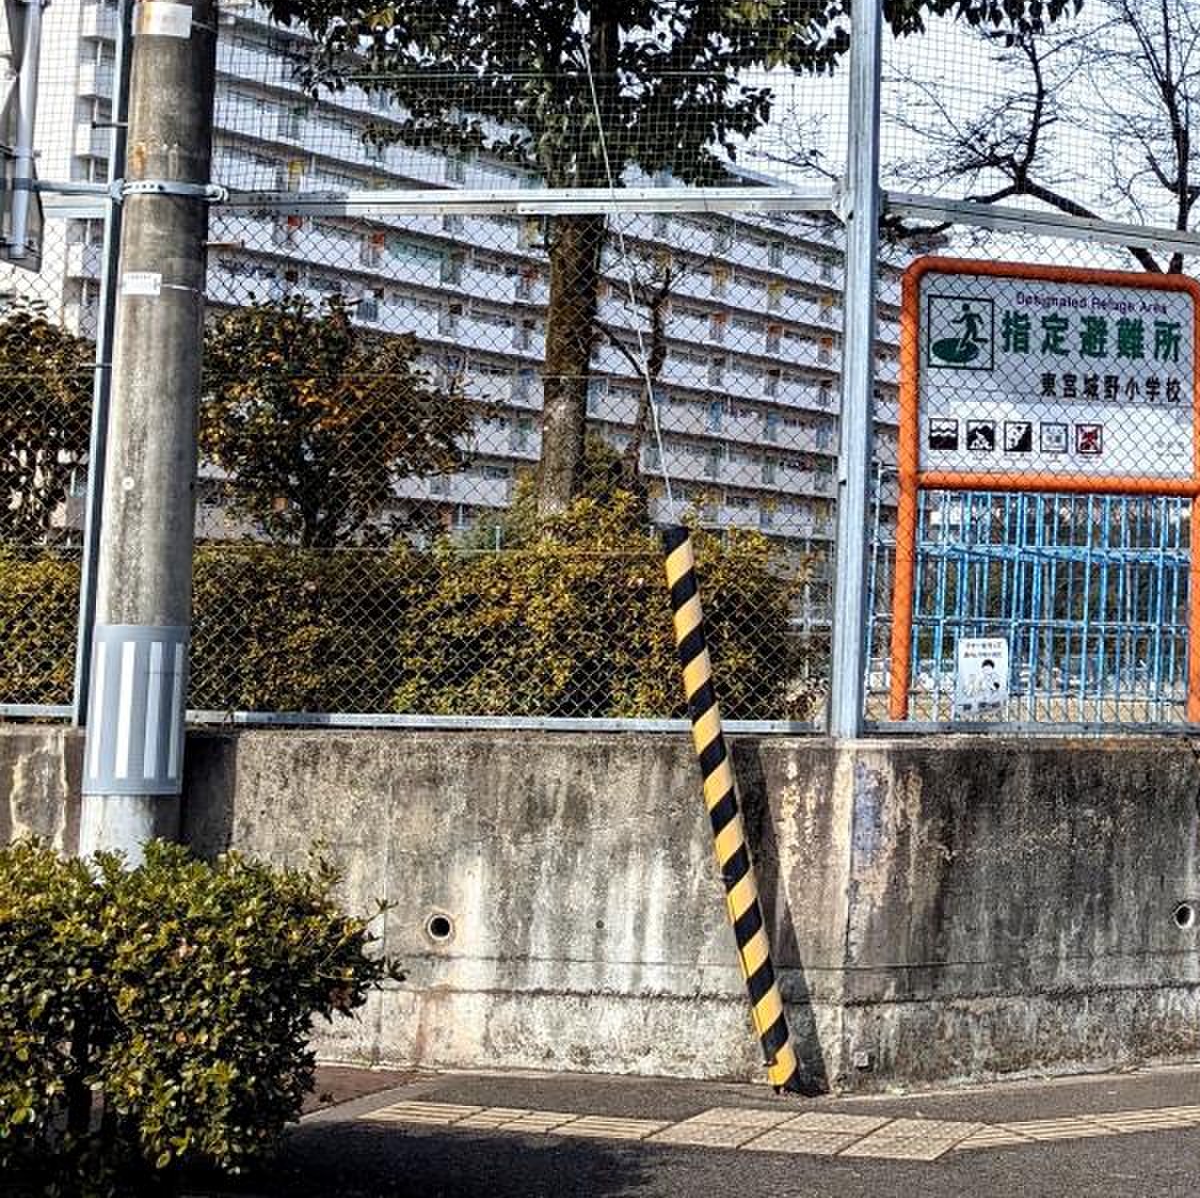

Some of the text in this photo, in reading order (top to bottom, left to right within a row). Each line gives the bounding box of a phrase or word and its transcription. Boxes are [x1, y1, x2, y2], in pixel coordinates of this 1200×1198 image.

[1001, 310, 1182, 363] 指定避難所
[1040, 372, 1182, 402] 東宮城野小学校
